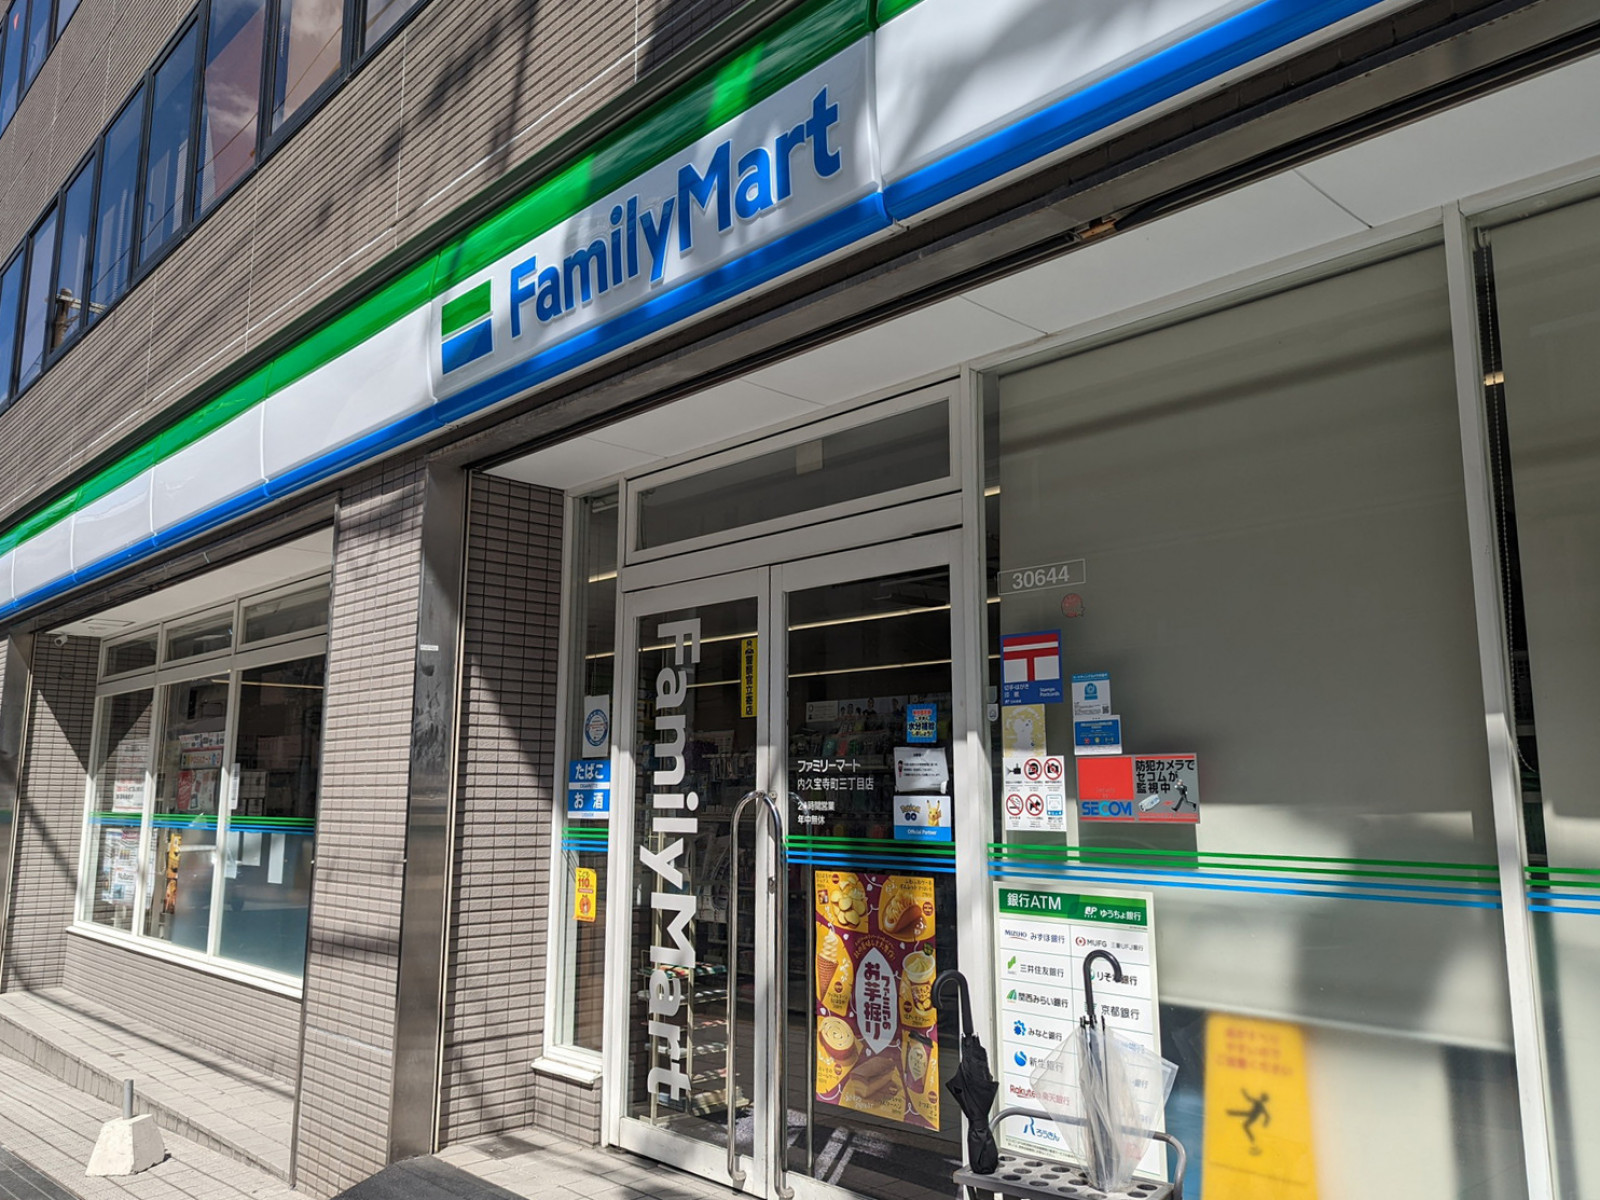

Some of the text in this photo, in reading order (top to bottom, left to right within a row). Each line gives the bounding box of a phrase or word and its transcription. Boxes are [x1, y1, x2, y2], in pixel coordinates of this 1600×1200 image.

[511, 85, 842, 339] FamilyMart
[1012, 565, 1070, 590] 30644
[575, 763, 604, 780] たばこ
[798, 759, 861, 773] ファミリーマート
[1135, 760, 1195, 772] 防犯カメラで
[797, 777, 874, 791] 内久宝寺町三丁目店
[1136, 771, 1178, 782] セコムが
[1136, 782, 1171, 794] 監視中
[1081, 801, 1132, 816] SECOM
[640, 617, 701, 1101] FamilyMart
[1007, 892, 1062, 911] 銀行ATM
[1100, 909, 1141, 921] ゆうちょ銀行
[1030, 932, 1065, 944] みずほ銀行
[1087, 939, 1107, 948] MUFG
[1020, 963, 1064, 978] 三井住友銀行
[1097, 971, 1138, 986] りそ銀行
[864, 961, 881, 1040] お芋掘り
[1018, 993, 1068, 1008] 関西みらい銀行
[1101, 1004, 1140, 1020] 京都銀行
[1028, 1028, 1063, 1041] みなと銀行
